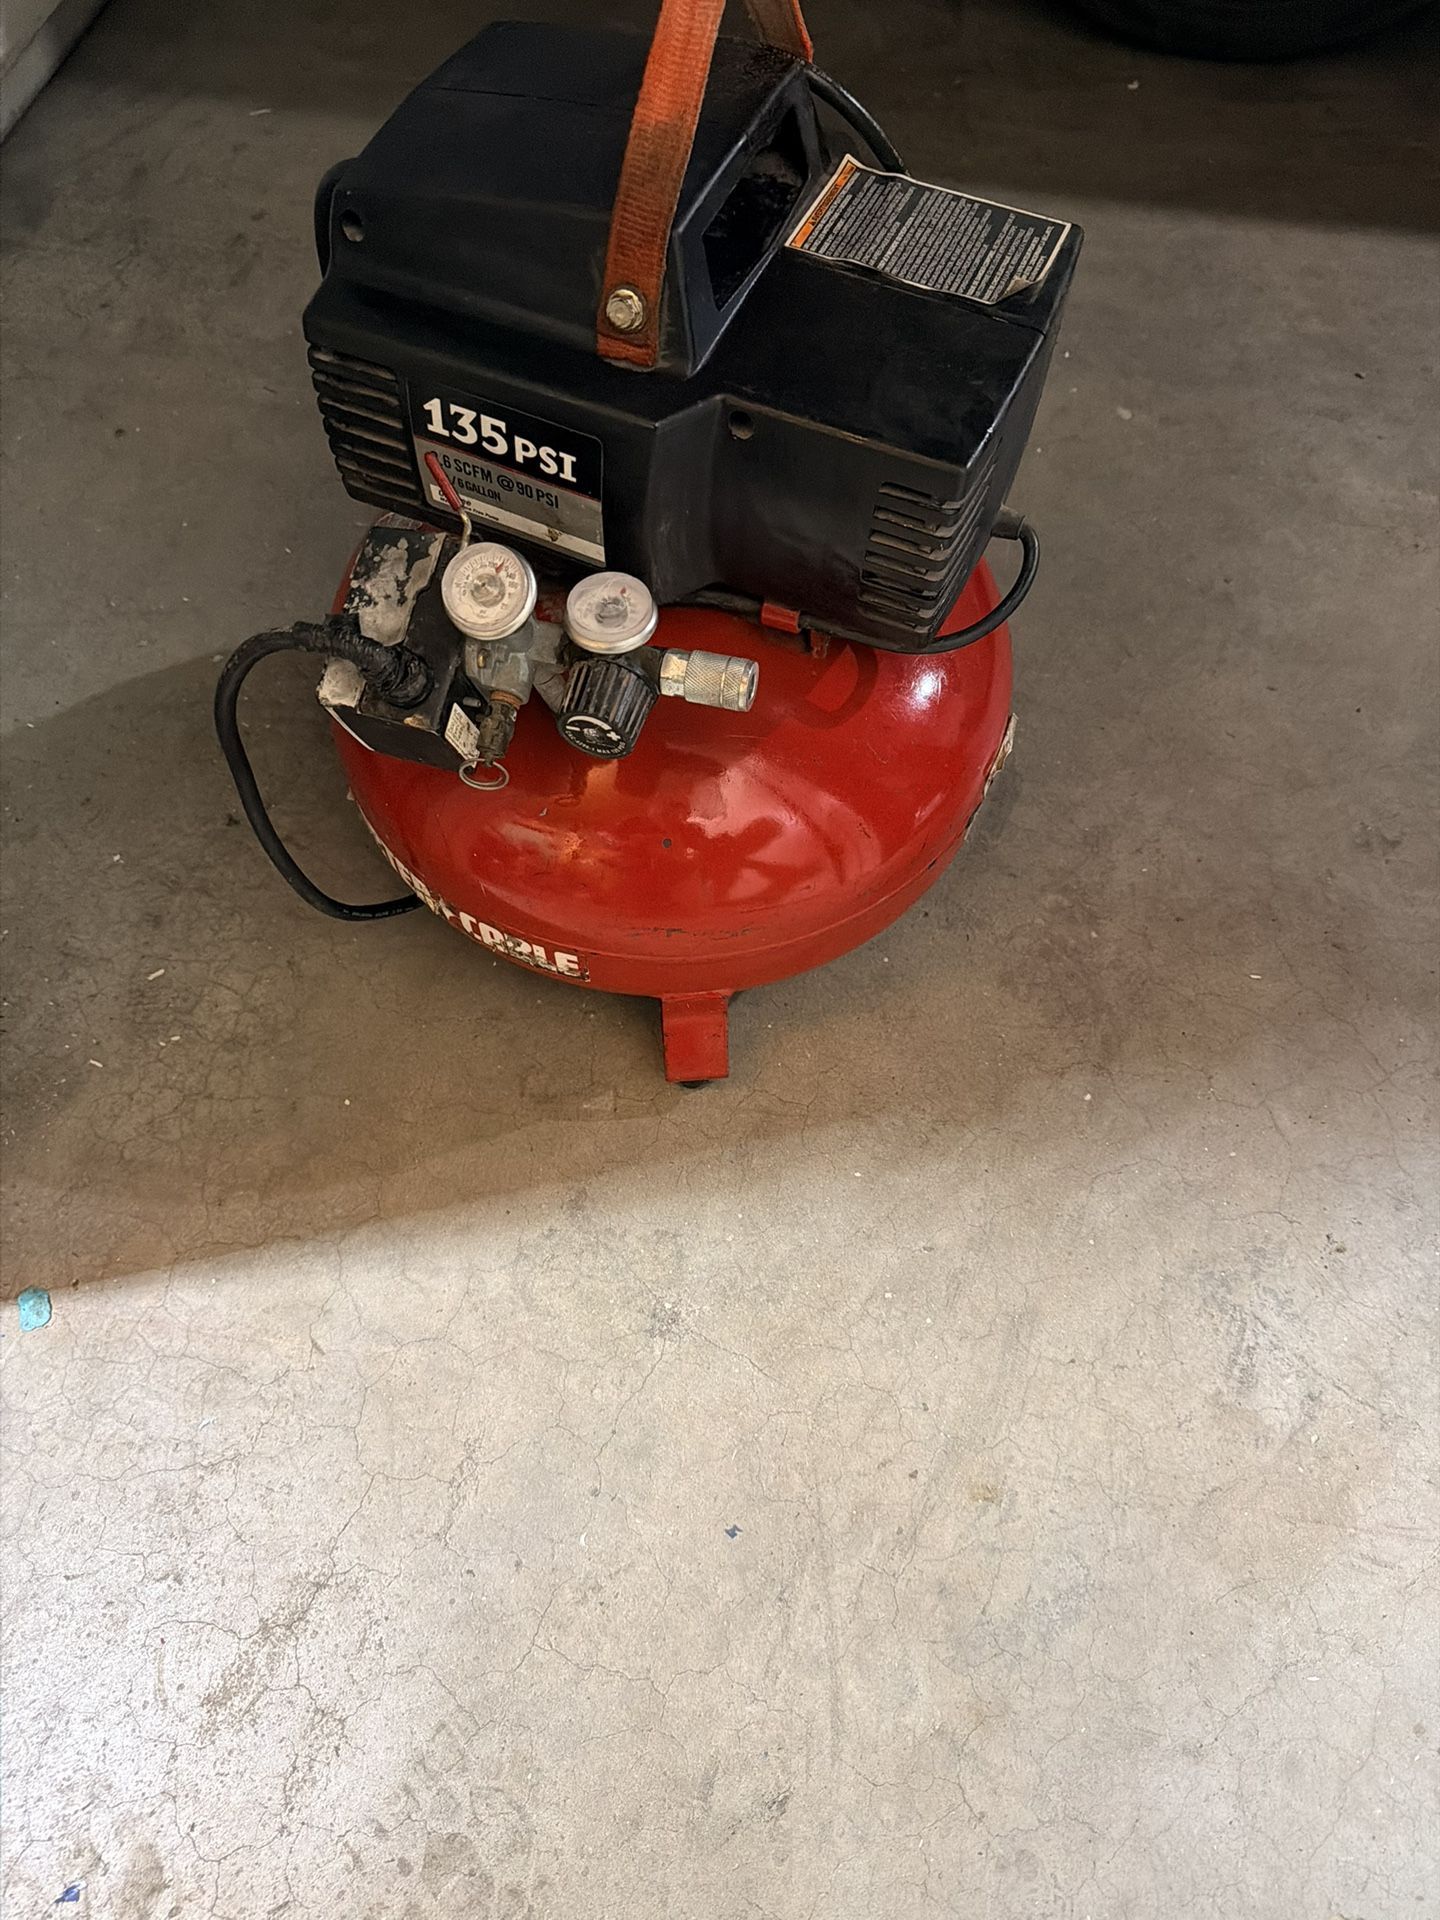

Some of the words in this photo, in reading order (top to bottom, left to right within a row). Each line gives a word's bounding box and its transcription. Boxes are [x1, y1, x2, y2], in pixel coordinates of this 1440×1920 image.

[423, 397, 508, 456] 135
[514, 435, 577, 483] PSI
[454, 457, 493, 484] SCFM
[497, 474, 515, 492] @
[516, 482, 534, 499] 90
[536, 488, 560, 509] PSI
[465, 481, 502, 502] GALLON
